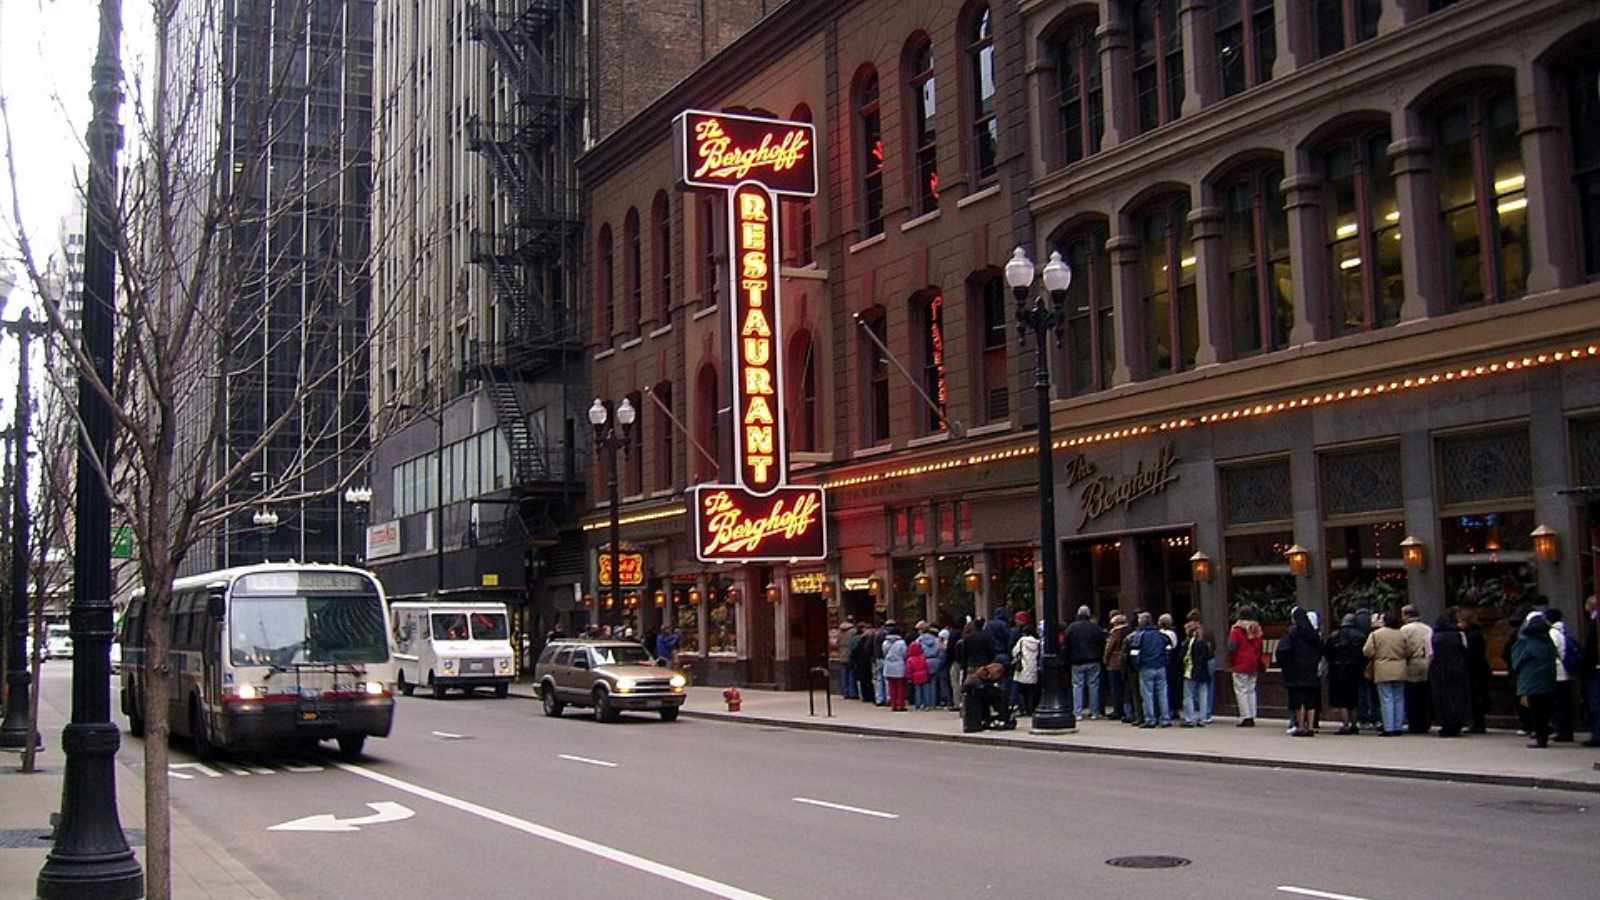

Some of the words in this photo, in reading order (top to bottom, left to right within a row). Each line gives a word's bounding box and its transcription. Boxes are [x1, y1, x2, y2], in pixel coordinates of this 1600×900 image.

[695, 119, 724, 141] The
[694, 136, 809, 178] Berghoff
[739, 193, 774, 483] RESTAURANT
[1066, 454, 1096, 488] The
[1076, 440, 1181, 532] Berghoff
[703, 492, 820, 556] Berghoff
[704, 491, 733, 516] The
